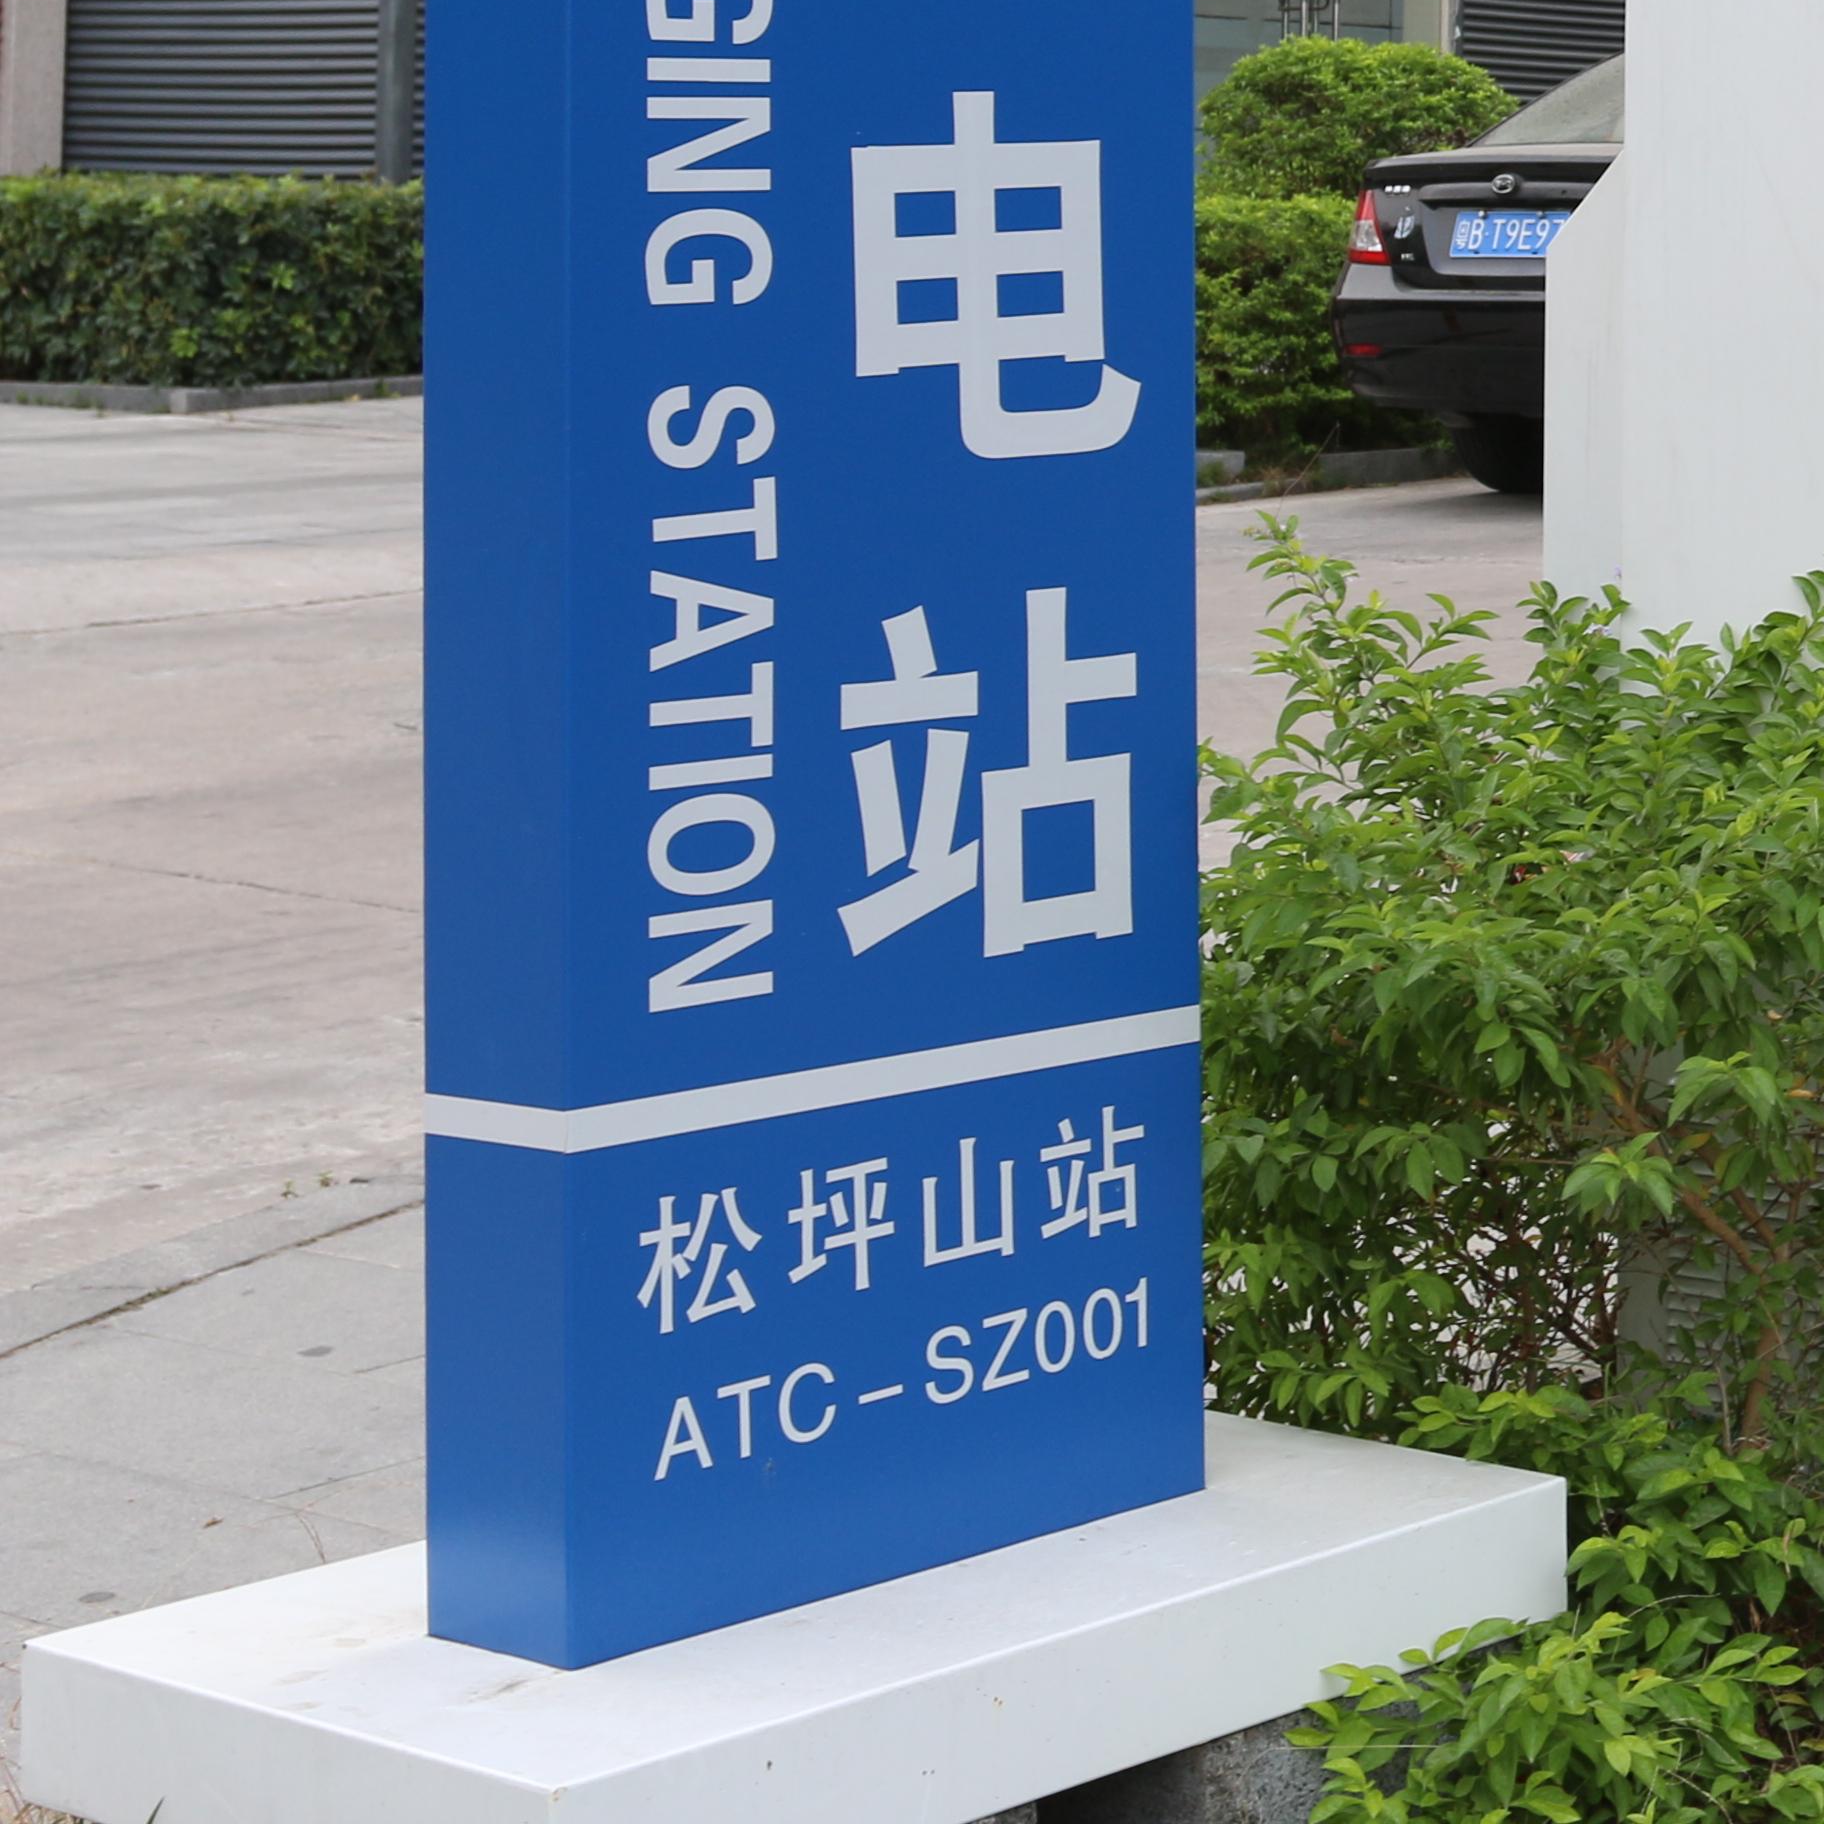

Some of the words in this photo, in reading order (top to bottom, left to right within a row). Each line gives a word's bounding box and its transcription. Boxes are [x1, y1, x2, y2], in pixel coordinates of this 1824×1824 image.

[646, 382, 779, 1014] STATION
[636, 1105, 1145, 1334] 松坪山站
[654, 1277, 1149, 1482] ATC-SZ001
